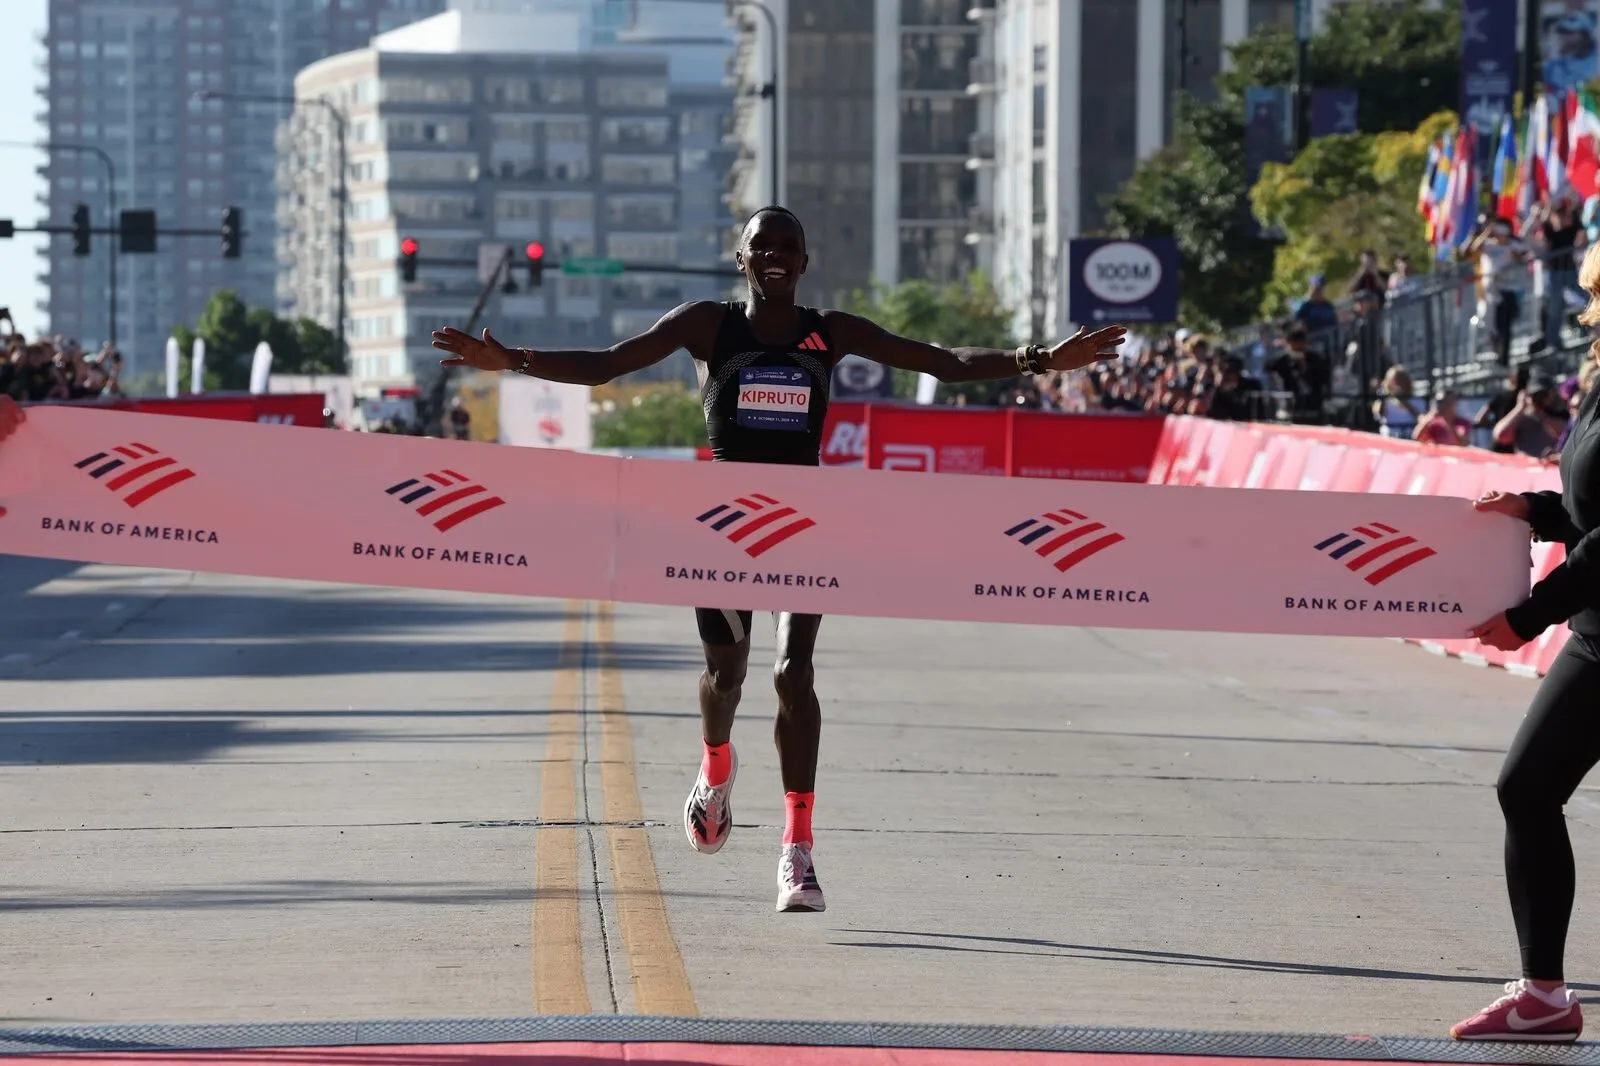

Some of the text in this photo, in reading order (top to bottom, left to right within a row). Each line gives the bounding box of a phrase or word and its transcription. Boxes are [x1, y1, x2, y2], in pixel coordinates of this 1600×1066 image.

[1096, 262, 1151, 280] 100M
[741, 390, 807, 406] KIPRUTO
[40, 516, 219, 544] BANK OF AMERICA
[352, 541, 529, 568] BANK OF AMERICA
[665, 565, 840, 589] BANK OF AMERICA
[974, 583, 1150, 604] BANK OF AMERICA
[1284, 596, 1464, 615] BANK OF AMERICA
